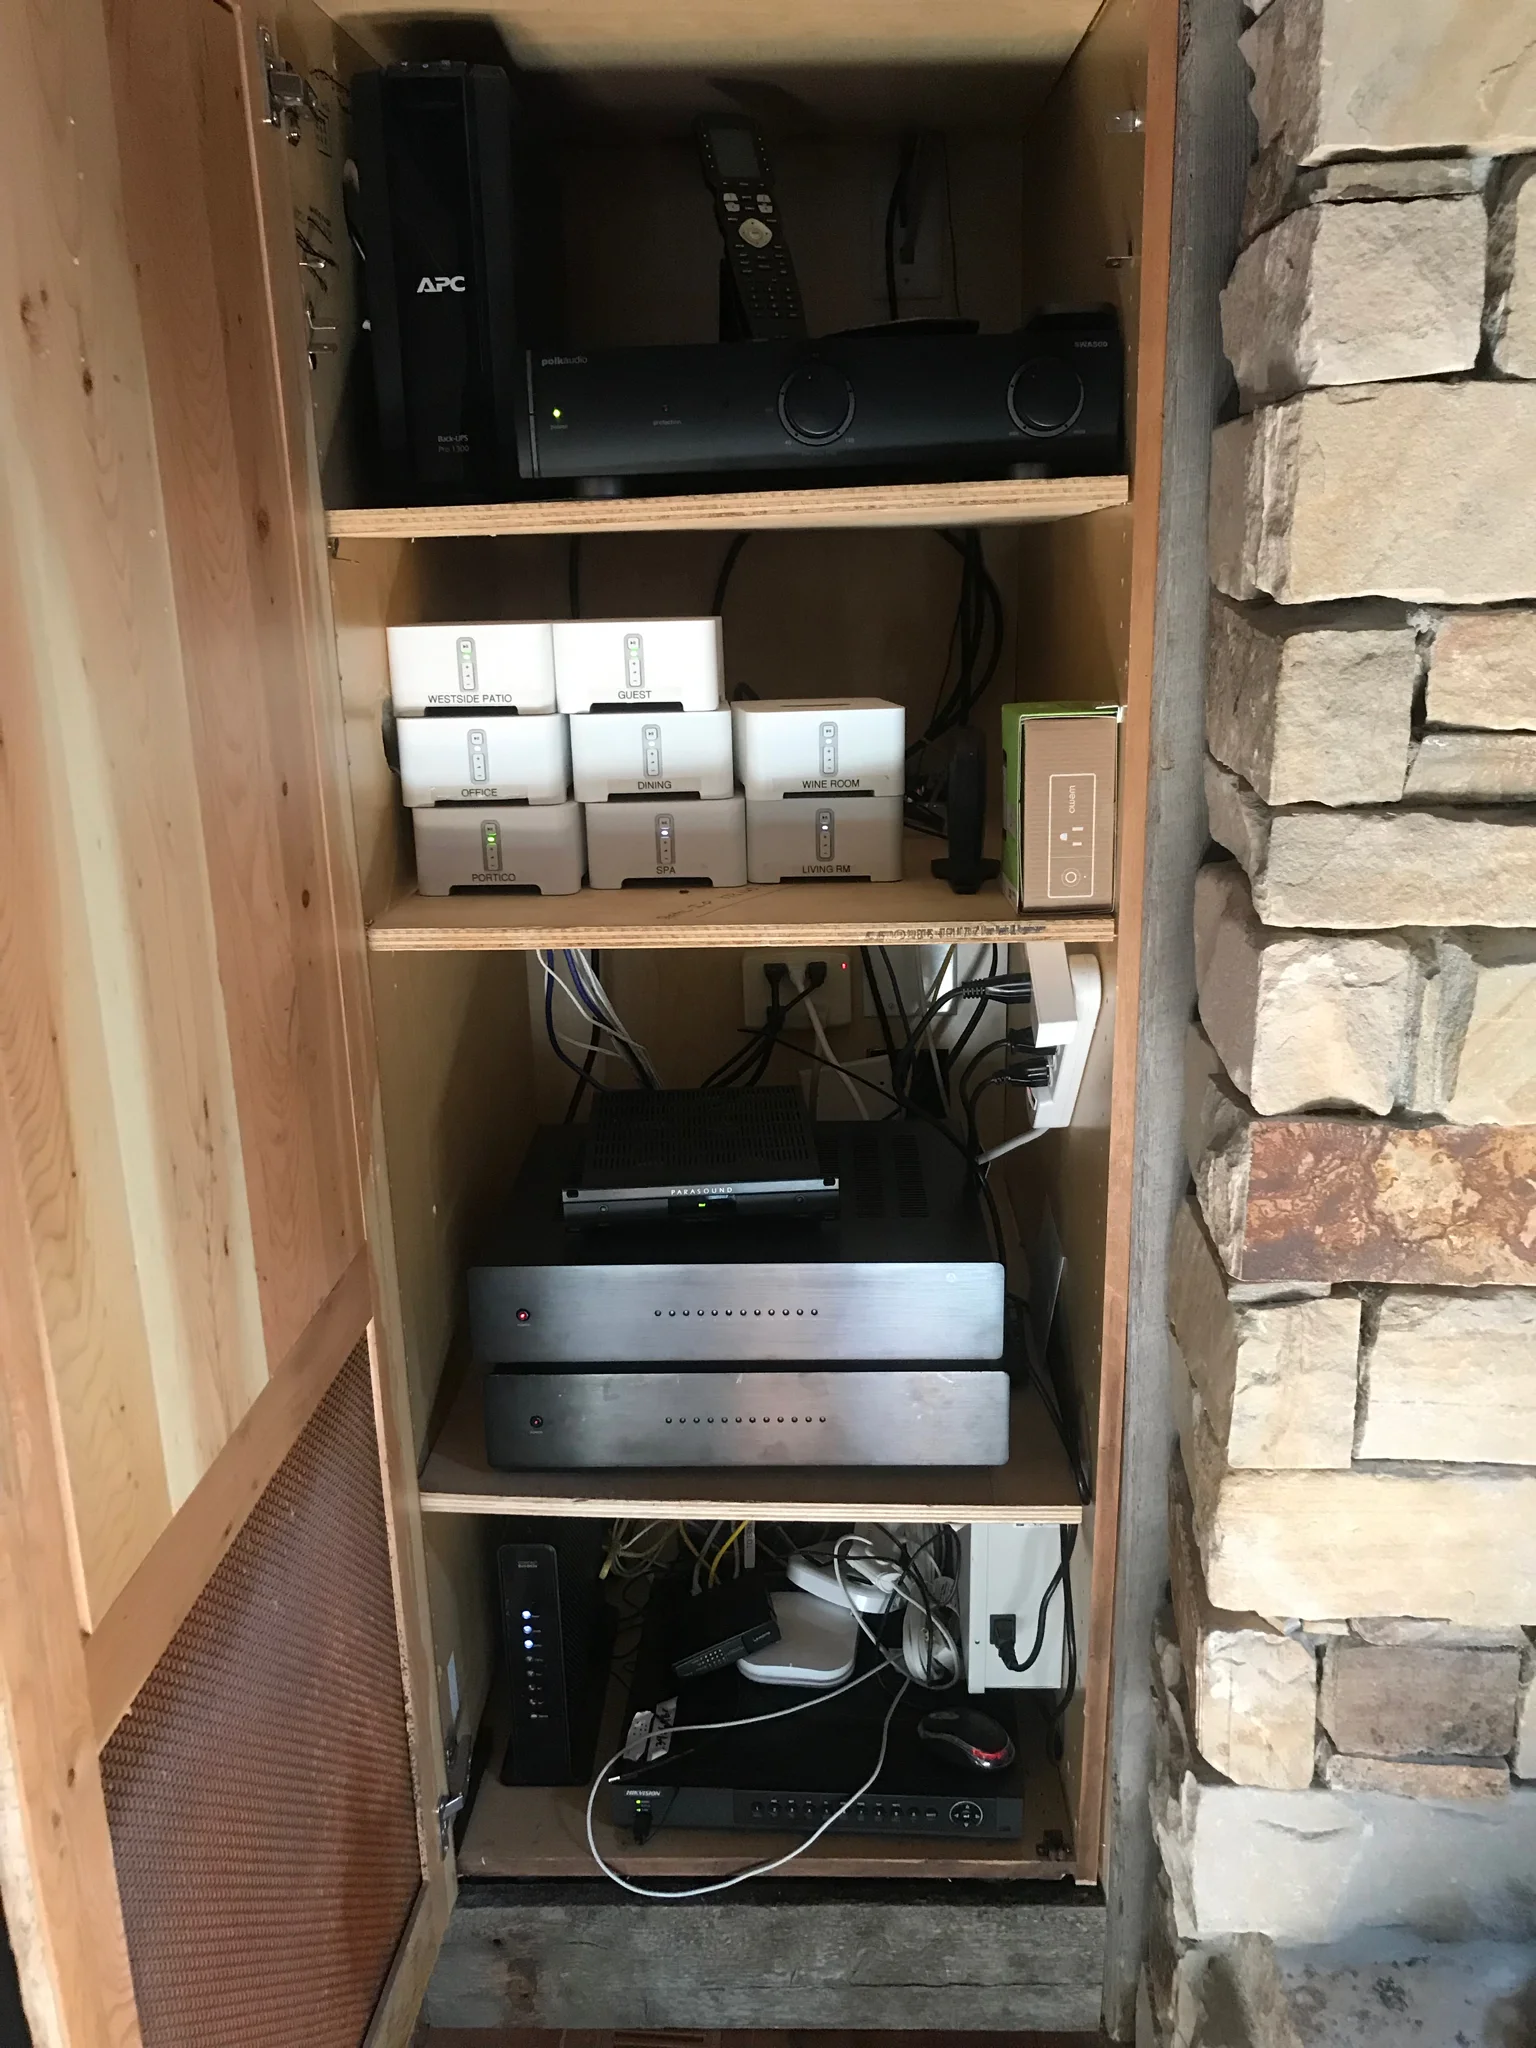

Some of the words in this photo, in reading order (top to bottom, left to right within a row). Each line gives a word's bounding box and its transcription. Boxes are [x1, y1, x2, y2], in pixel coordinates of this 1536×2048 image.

[416, 275, 467, 294] APC
[541, 355, 588, 367] polkaudio
[428, 695, 480, 704] WESTSIDE
[482, 694, 513, 703] PATIO
[617, 690, 652, 700] GUEST
[637, 780, 672, 790] DINING
[802, 780, 828, 789] WINE
[830, 779, 860, 788] ROOM
[461, 788, 498, 797] OFFICE
[1068, 785, 1076, 814] wemo
[656, 865, 676, 875] SPA
[802, 865, 834, 874] LIVING
[836, 864, 851, 873] RM
[472, 873, 517, 882] PORTICO
[670, 1187, 734, 1196] PARASOUND
